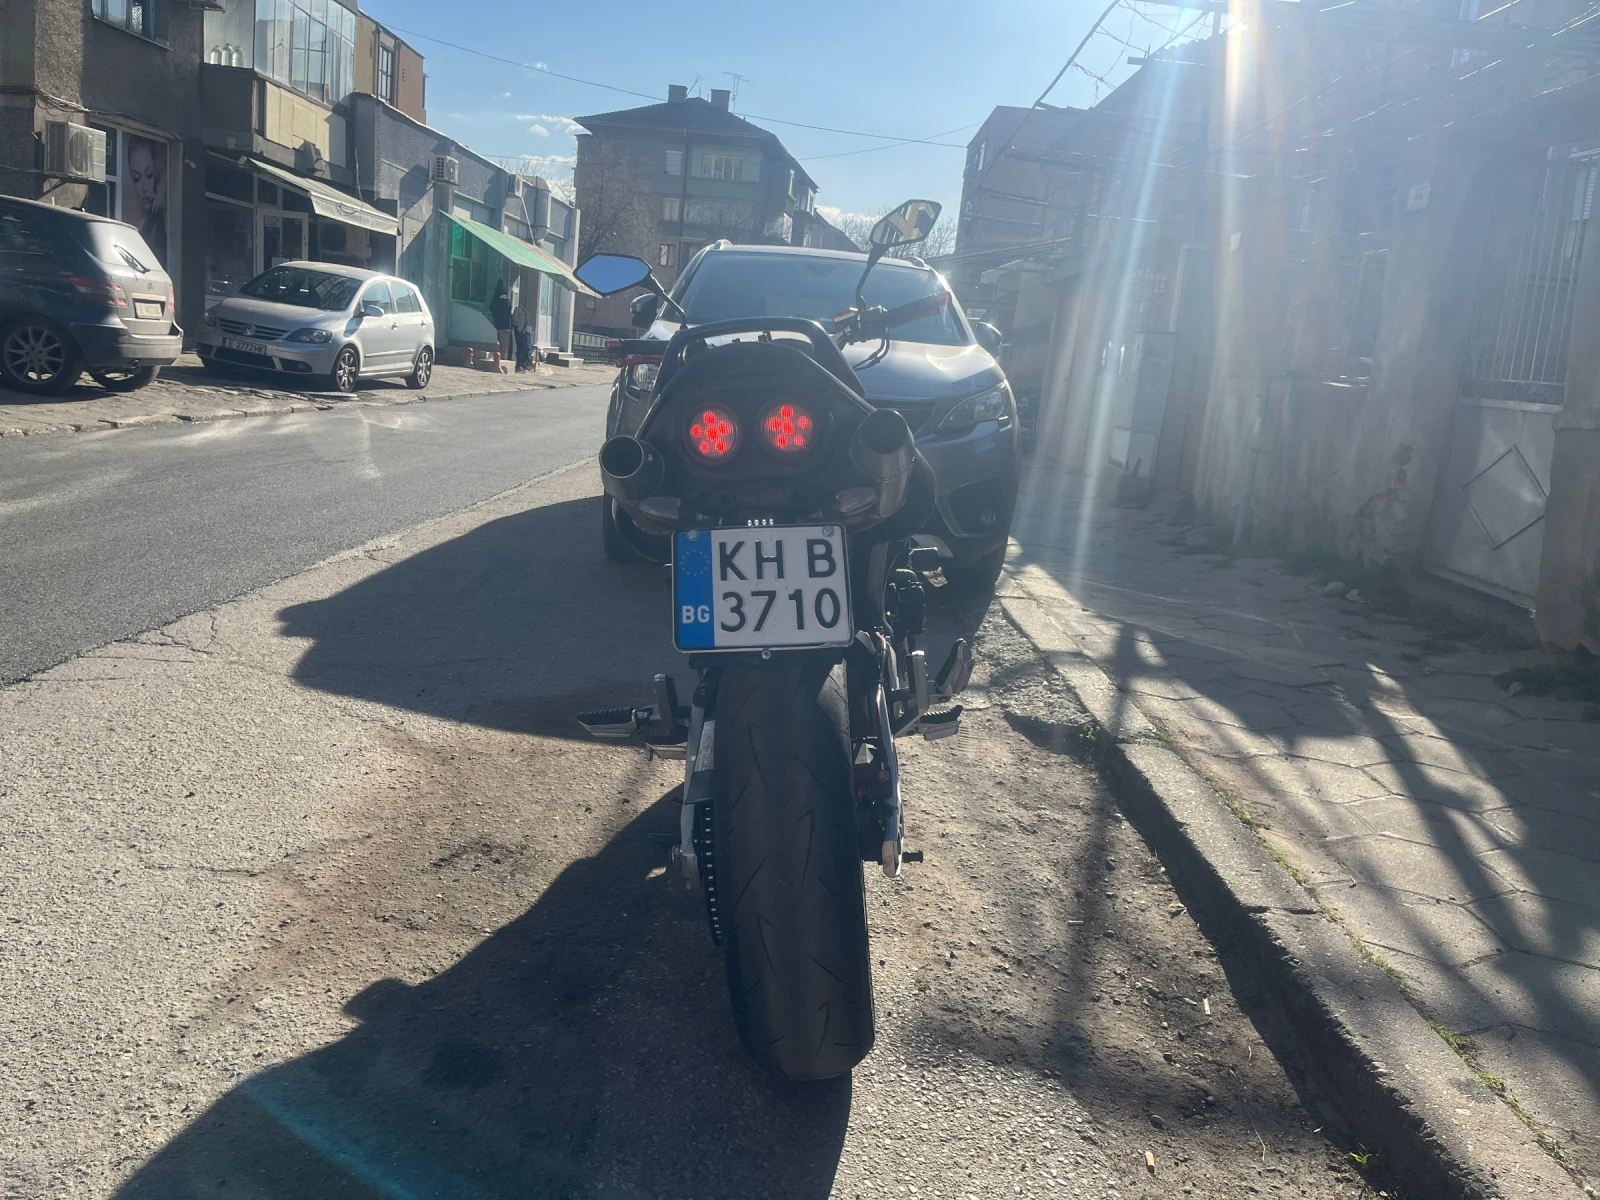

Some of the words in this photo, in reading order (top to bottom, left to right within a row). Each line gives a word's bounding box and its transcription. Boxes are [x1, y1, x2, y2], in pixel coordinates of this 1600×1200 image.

[718, 540, 784, 581] KH
[806, 539, 836, 578] B
[682, 605, 710, 624] BG
[720, 588, 841, 632] 3710
